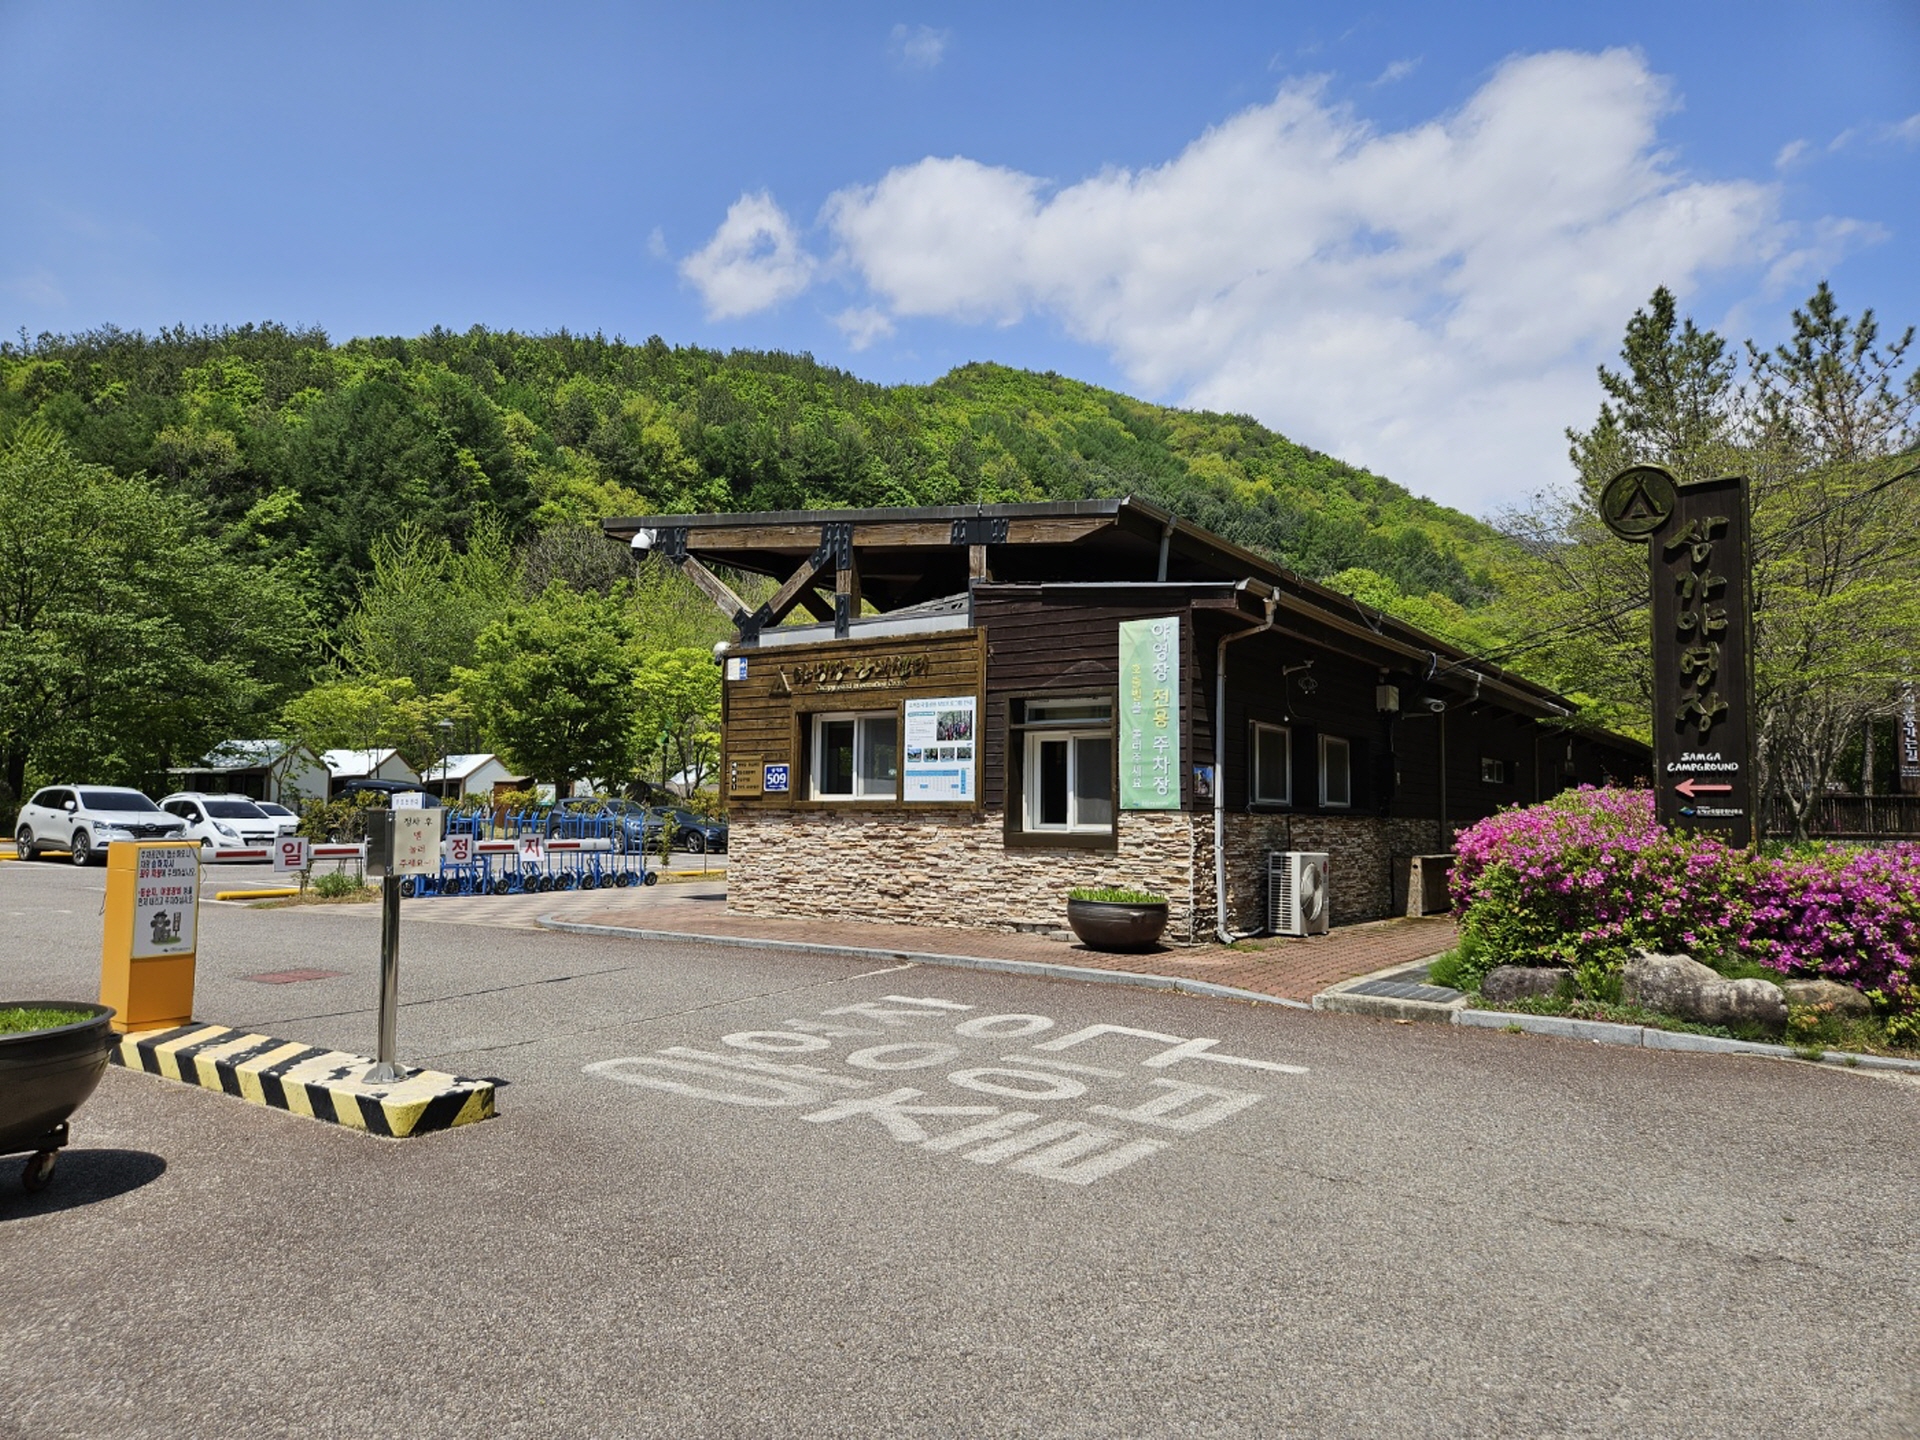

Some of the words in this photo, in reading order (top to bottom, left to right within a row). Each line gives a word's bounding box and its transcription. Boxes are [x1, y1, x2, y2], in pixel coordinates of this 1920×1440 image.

[1152, 623, 1171, 682] 야영장
[1152, 688, 1170, 729] 전용
[1152, 735, 1171, 796] 주차장
[1667, 762, 1739, 772] CAMPGROUND
[1681, 752, 1721, 762] SAMGA
[767, 773, 787, 785] 509
[282, 842, 302, 866] 일
[452, 838, 469, 861] 정
[524, 837, 540, 856] 지
[581, 995, 1054, 1106] 야영장
[800, 1023, 1311, 1186] 출입구
